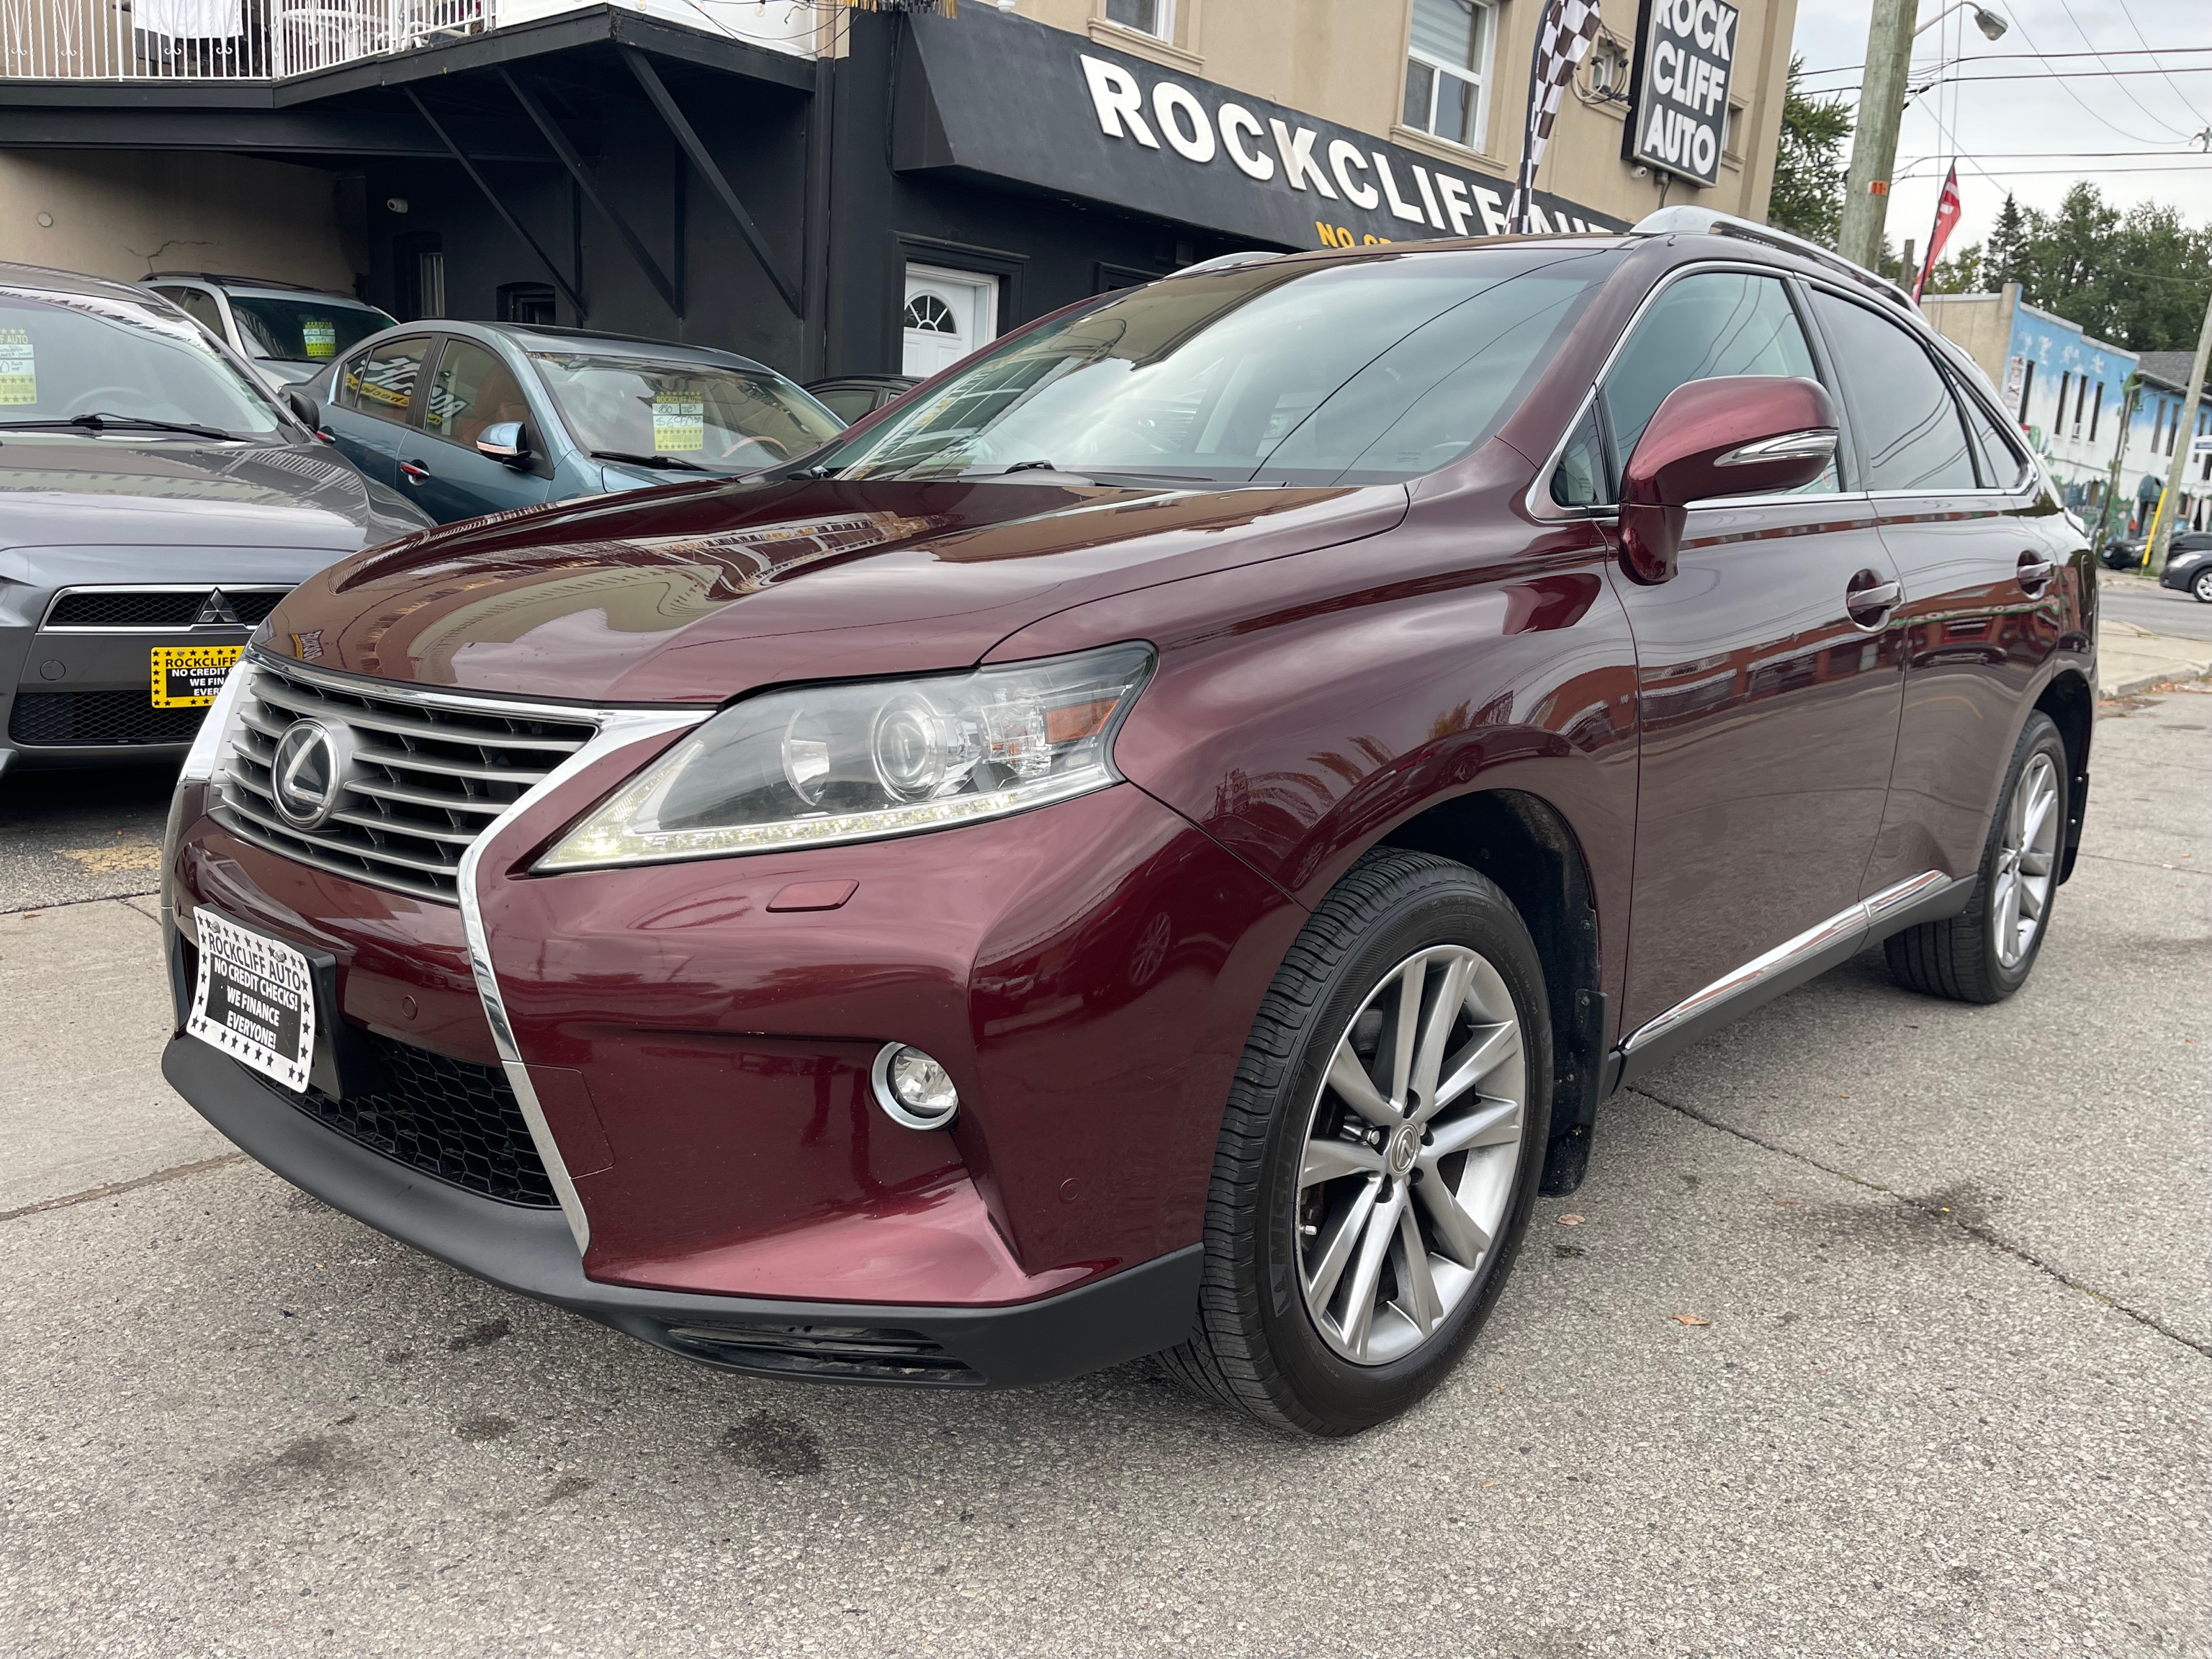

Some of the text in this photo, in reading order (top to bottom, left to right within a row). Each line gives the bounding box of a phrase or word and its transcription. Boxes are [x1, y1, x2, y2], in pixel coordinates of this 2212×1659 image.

[1653, 40, 1725, 117] CLIFF
[1080, 54, 1507, 236] ROCKCLIFF
[1644, 103, 1716, 175] AUTO
[1316, 221, 1355, 248] NO
[7, 335, 28, 343] AUTO
[166, 657, 236, 667] ROCKCLIFF
[190, 667, 226, 676] CREDIT
[189, 678, 206, 687] WE
[209, 932, 301, 992] ROCKCLIFF AUTO
[214, 957, 298, 1012] NO CREDIT CHECKS!
[227, 985, 279, 1027] WE FINANCE
[227, 1010, 276, 1049] EVERYONE!
